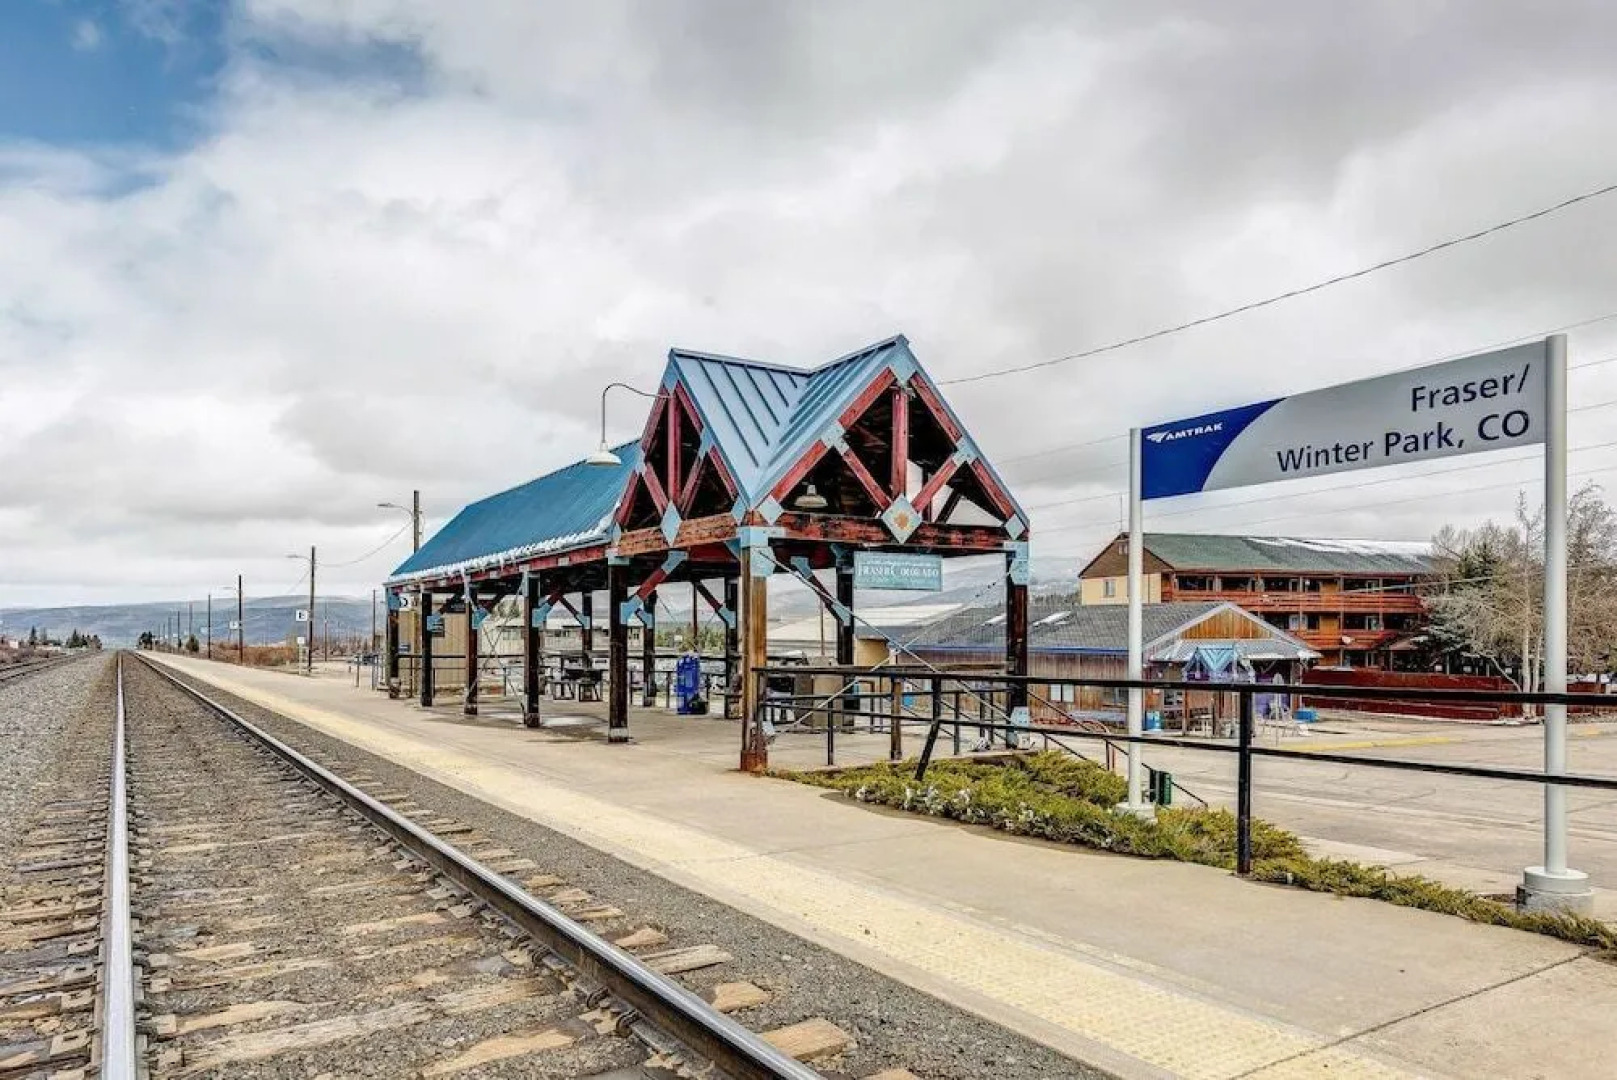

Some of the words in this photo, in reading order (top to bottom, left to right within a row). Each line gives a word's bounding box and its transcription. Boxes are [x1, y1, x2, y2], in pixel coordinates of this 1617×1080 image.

[1411, 363, 1530, 412] Fraser/
[1165, 422, 1224, 441] AMTRAK
[1276, 440, 1374, 472] Winter
[1384, 421, 1465, 456] Park,
[1477, 409, 1530, 441] CO
